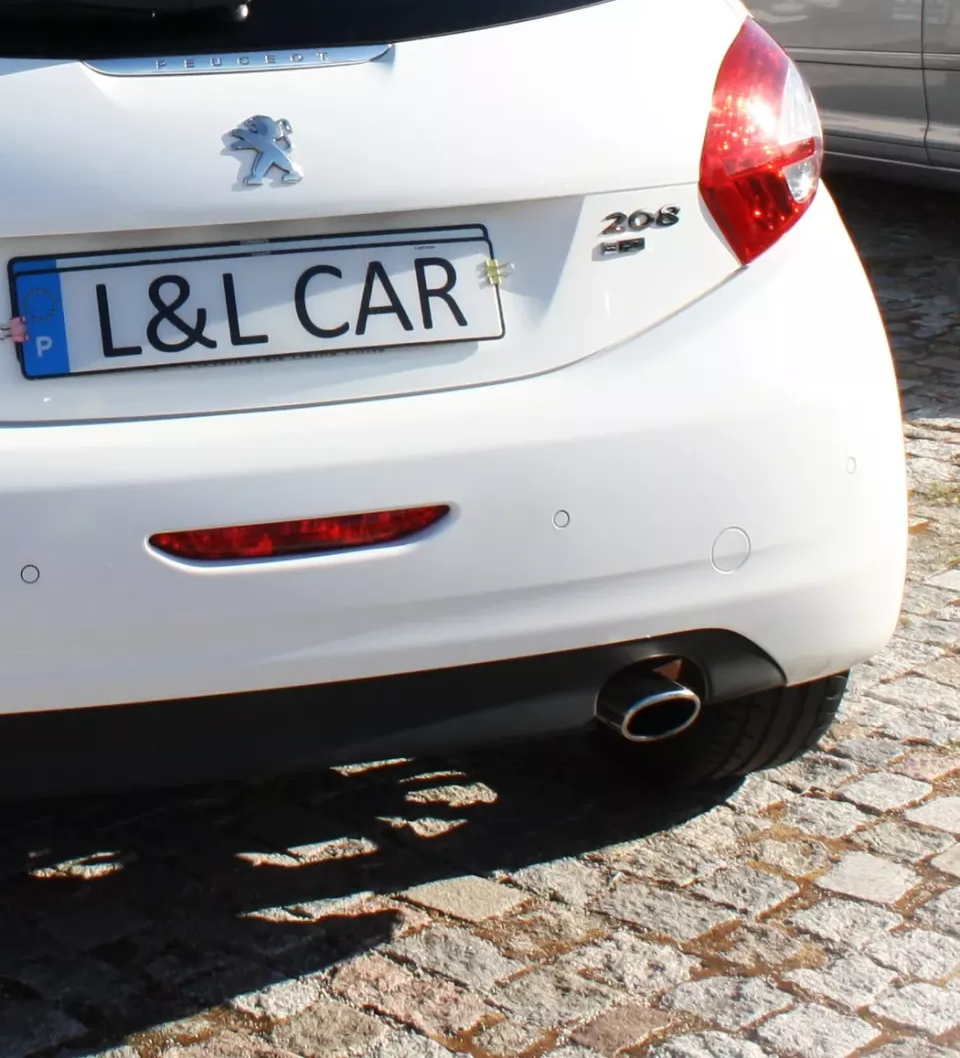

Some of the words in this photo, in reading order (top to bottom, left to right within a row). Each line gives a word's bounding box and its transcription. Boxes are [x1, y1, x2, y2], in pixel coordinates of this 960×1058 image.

[155, 51, 329, 70] PEUGEOT
[95, 272, 270, 359] L&L
[294, 256, 469, 339] CAR
[36, 335, 53, 357] P
